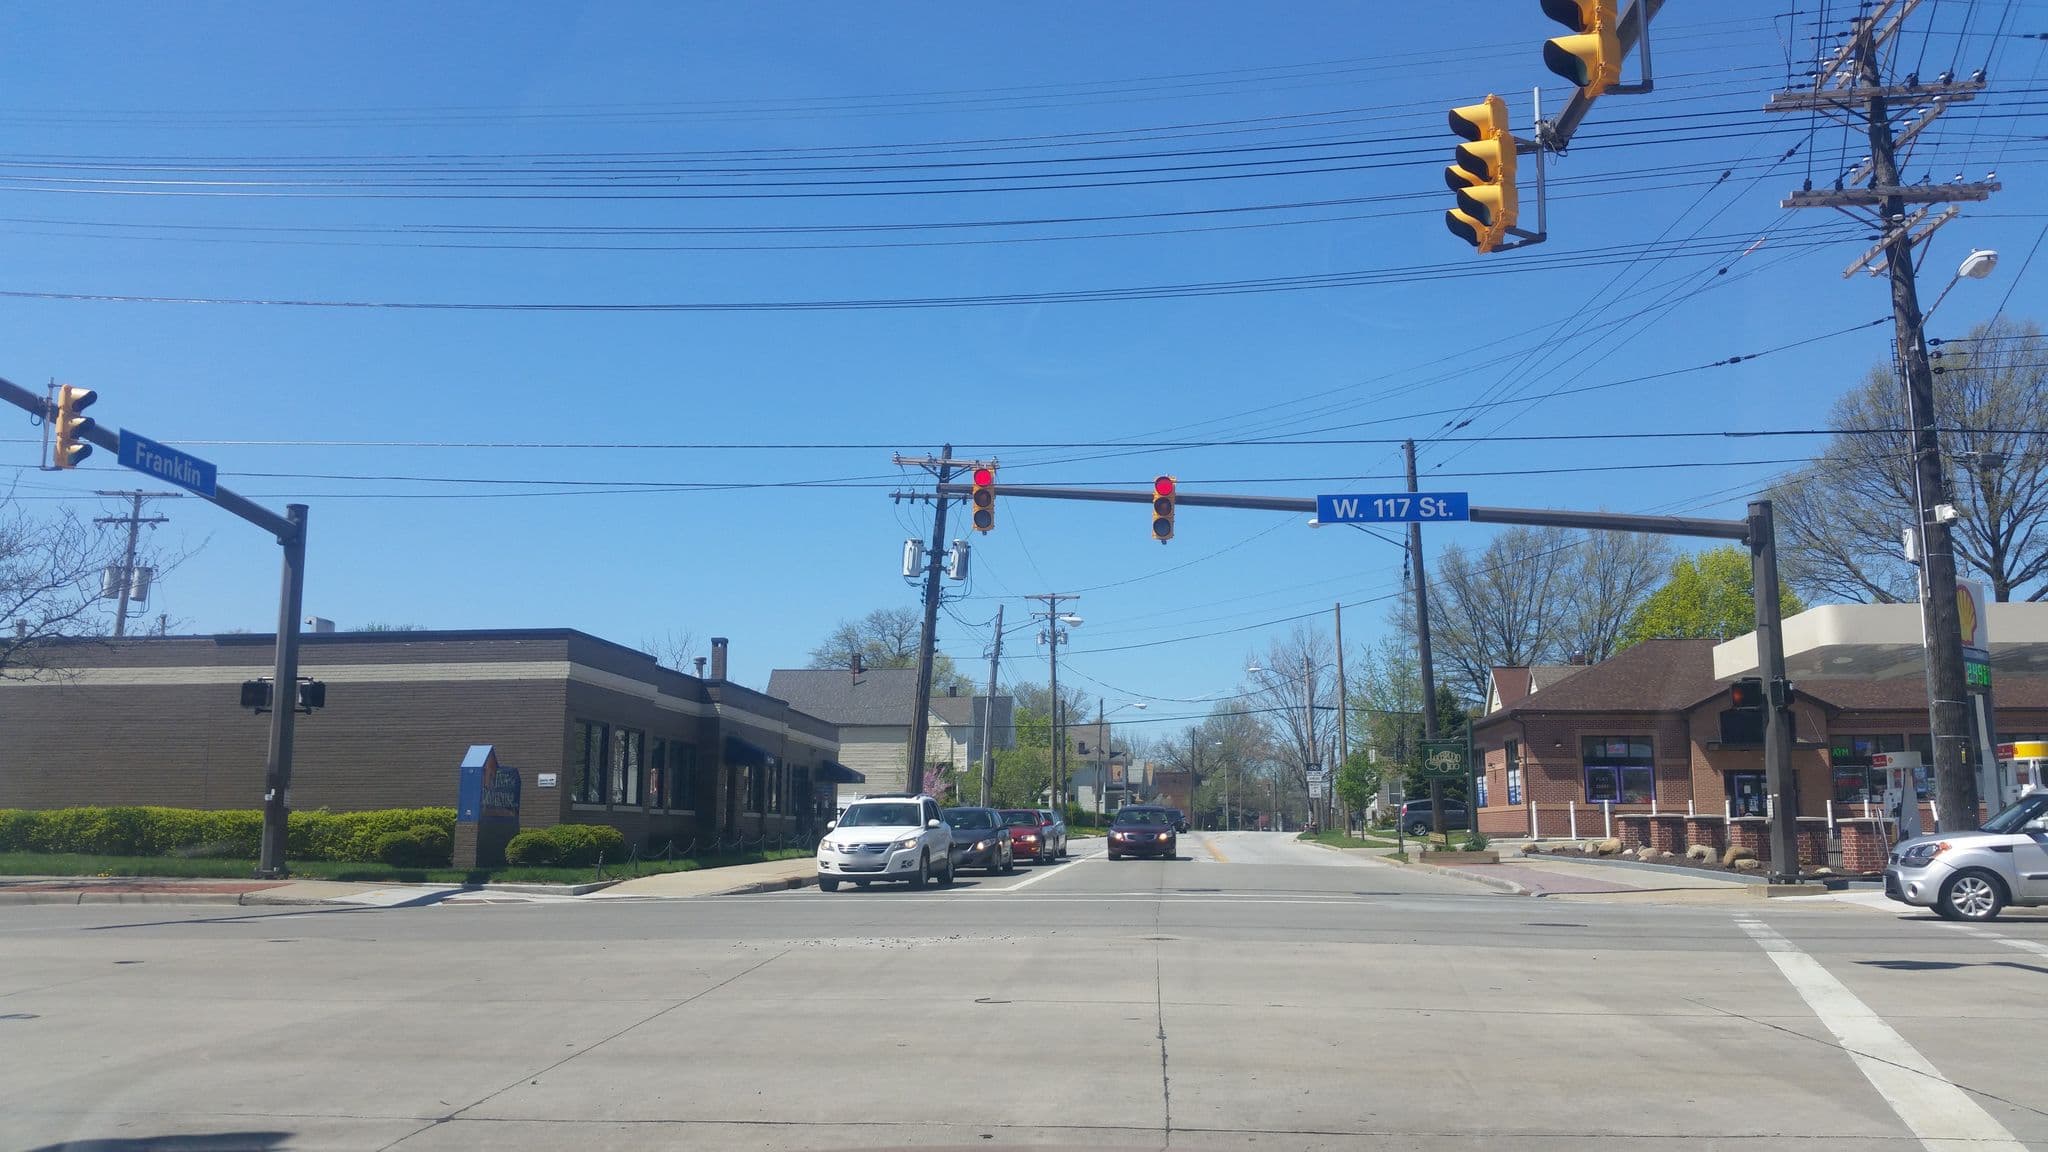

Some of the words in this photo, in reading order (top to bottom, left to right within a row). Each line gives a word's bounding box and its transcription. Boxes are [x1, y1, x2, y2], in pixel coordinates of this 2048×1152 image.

[135, 441, 201, 487] Franklin
[1332, 498, 1363, 519] W.
[1373, 498, 1411, 518] 117
[1419, 497, 1453, 518] St.
